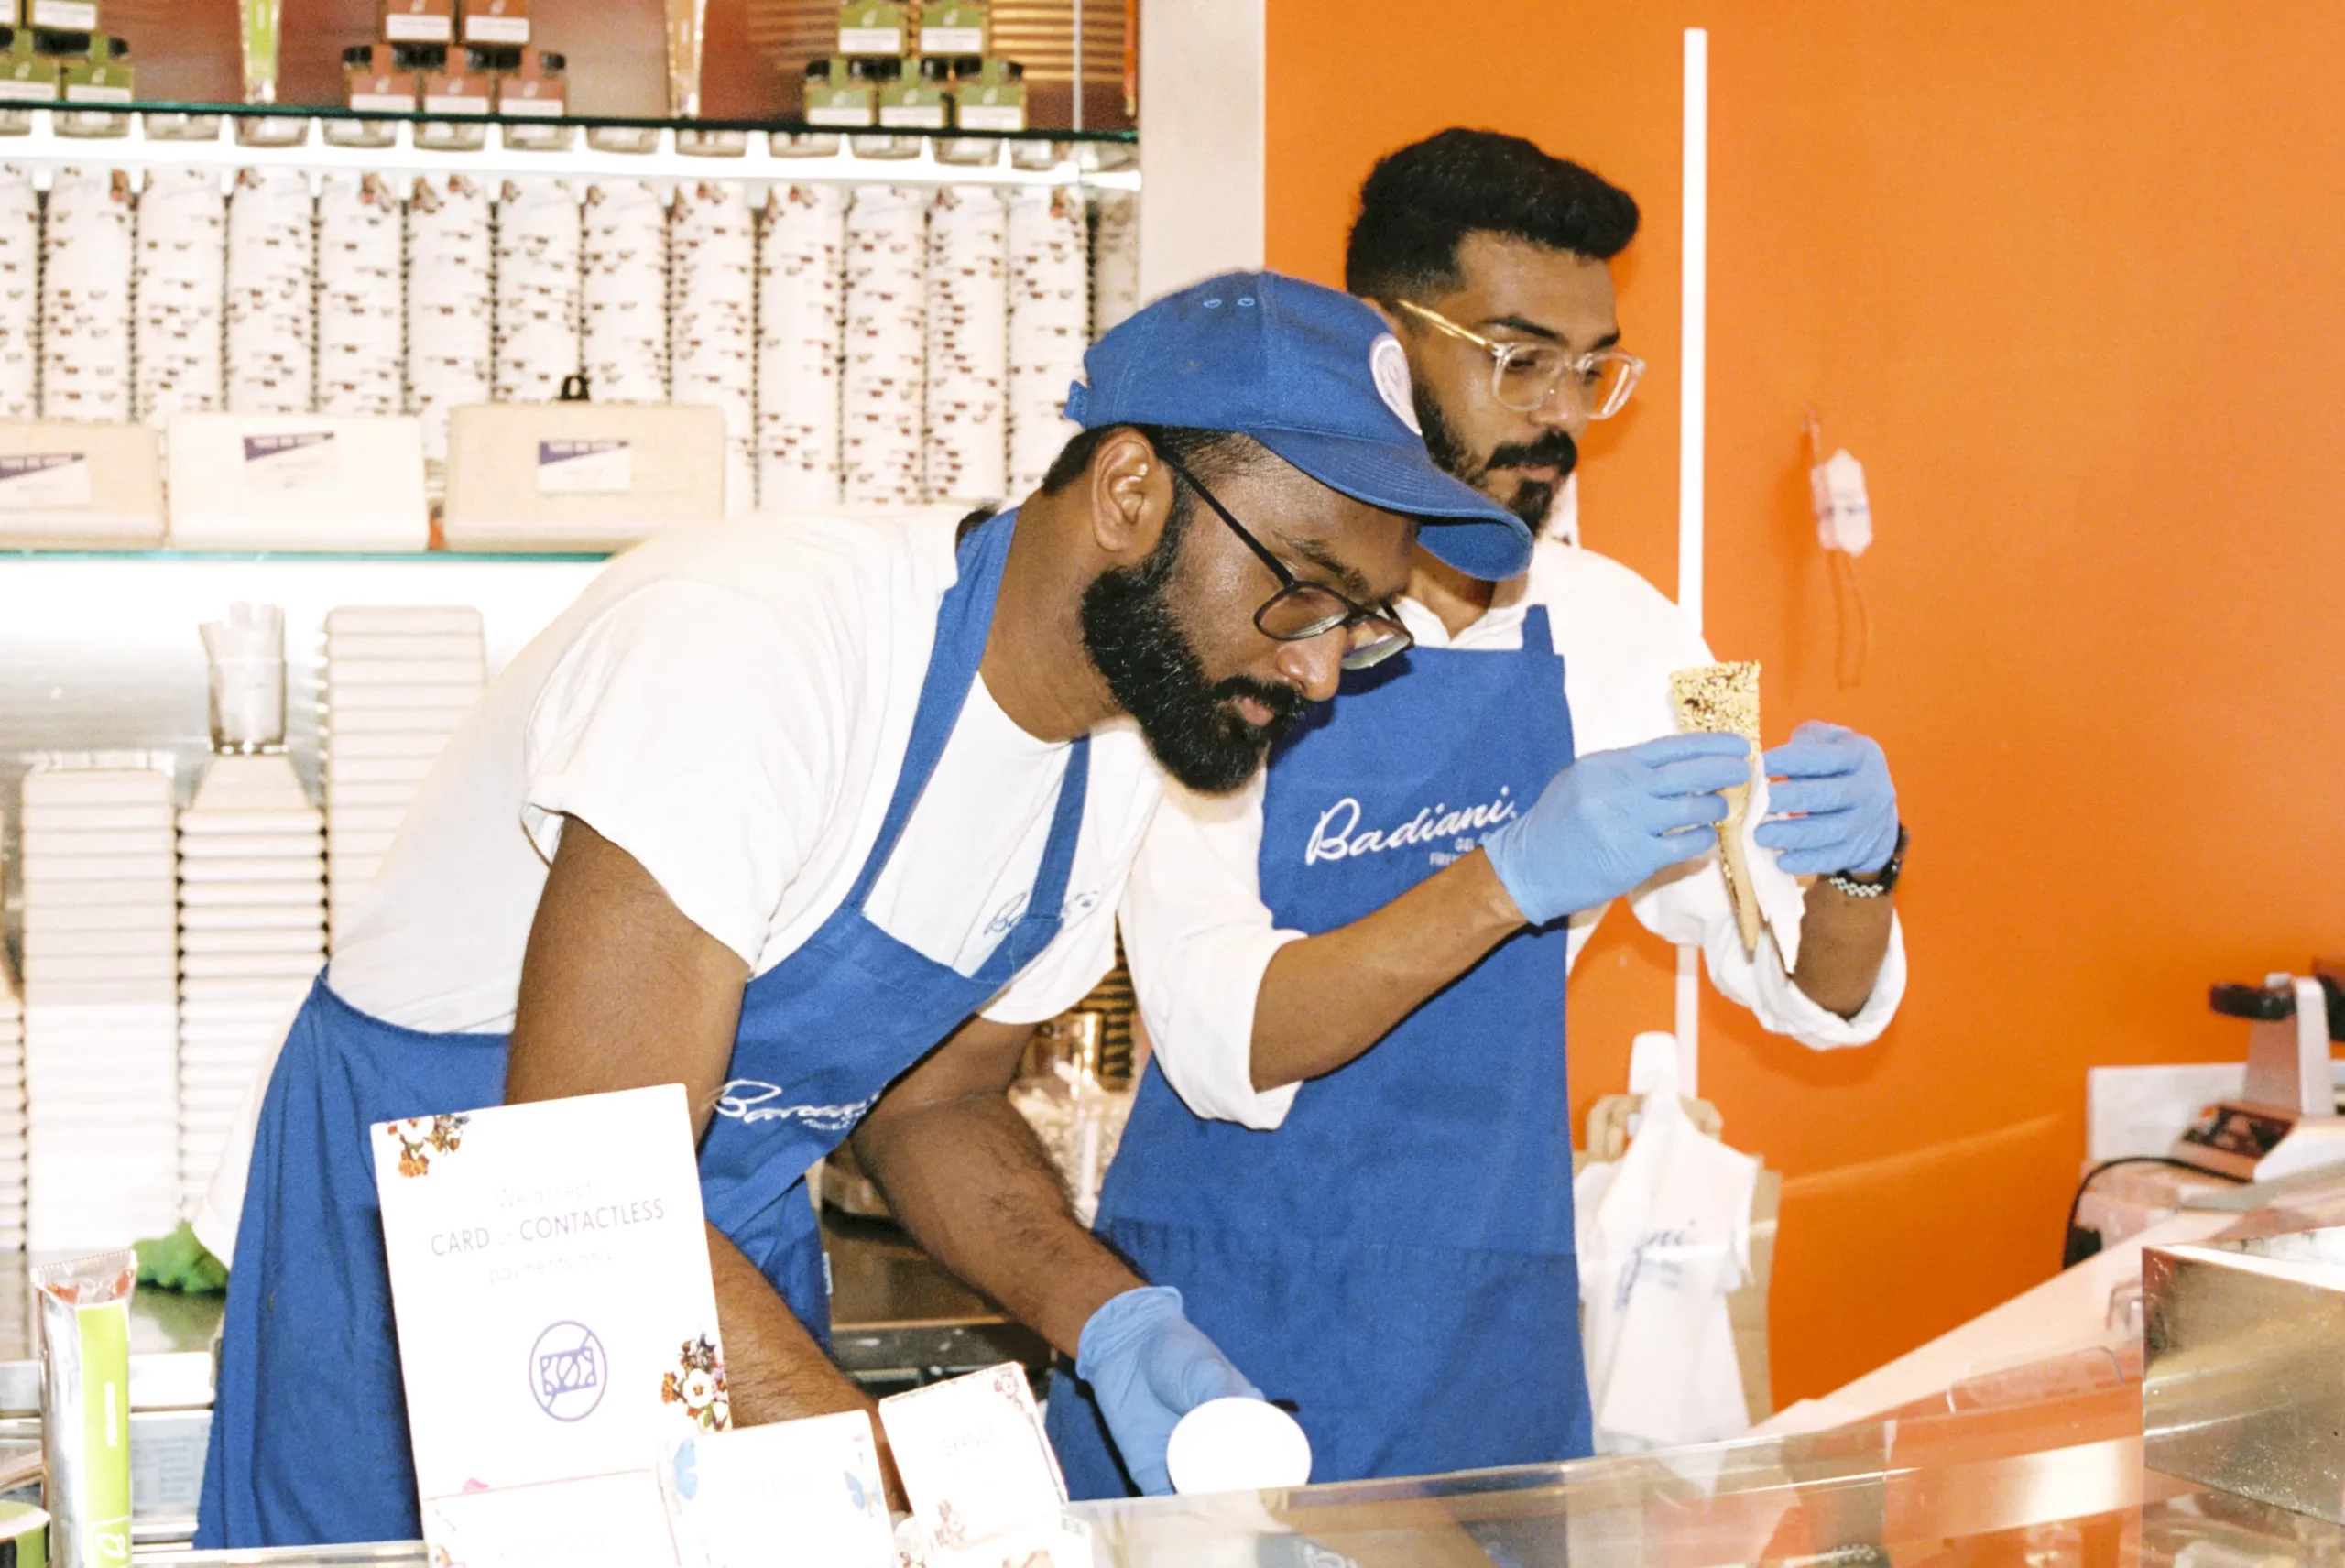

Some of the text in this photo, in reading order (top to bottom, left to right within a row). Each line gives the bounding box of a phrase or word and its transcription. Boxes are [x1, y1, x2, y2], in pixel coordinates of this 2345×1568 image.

[496, 1186, 527, 1210] We
[431, 1226, 490, 1257] CARD
[519, 1198, 665, 1241] CONTACTLESS
